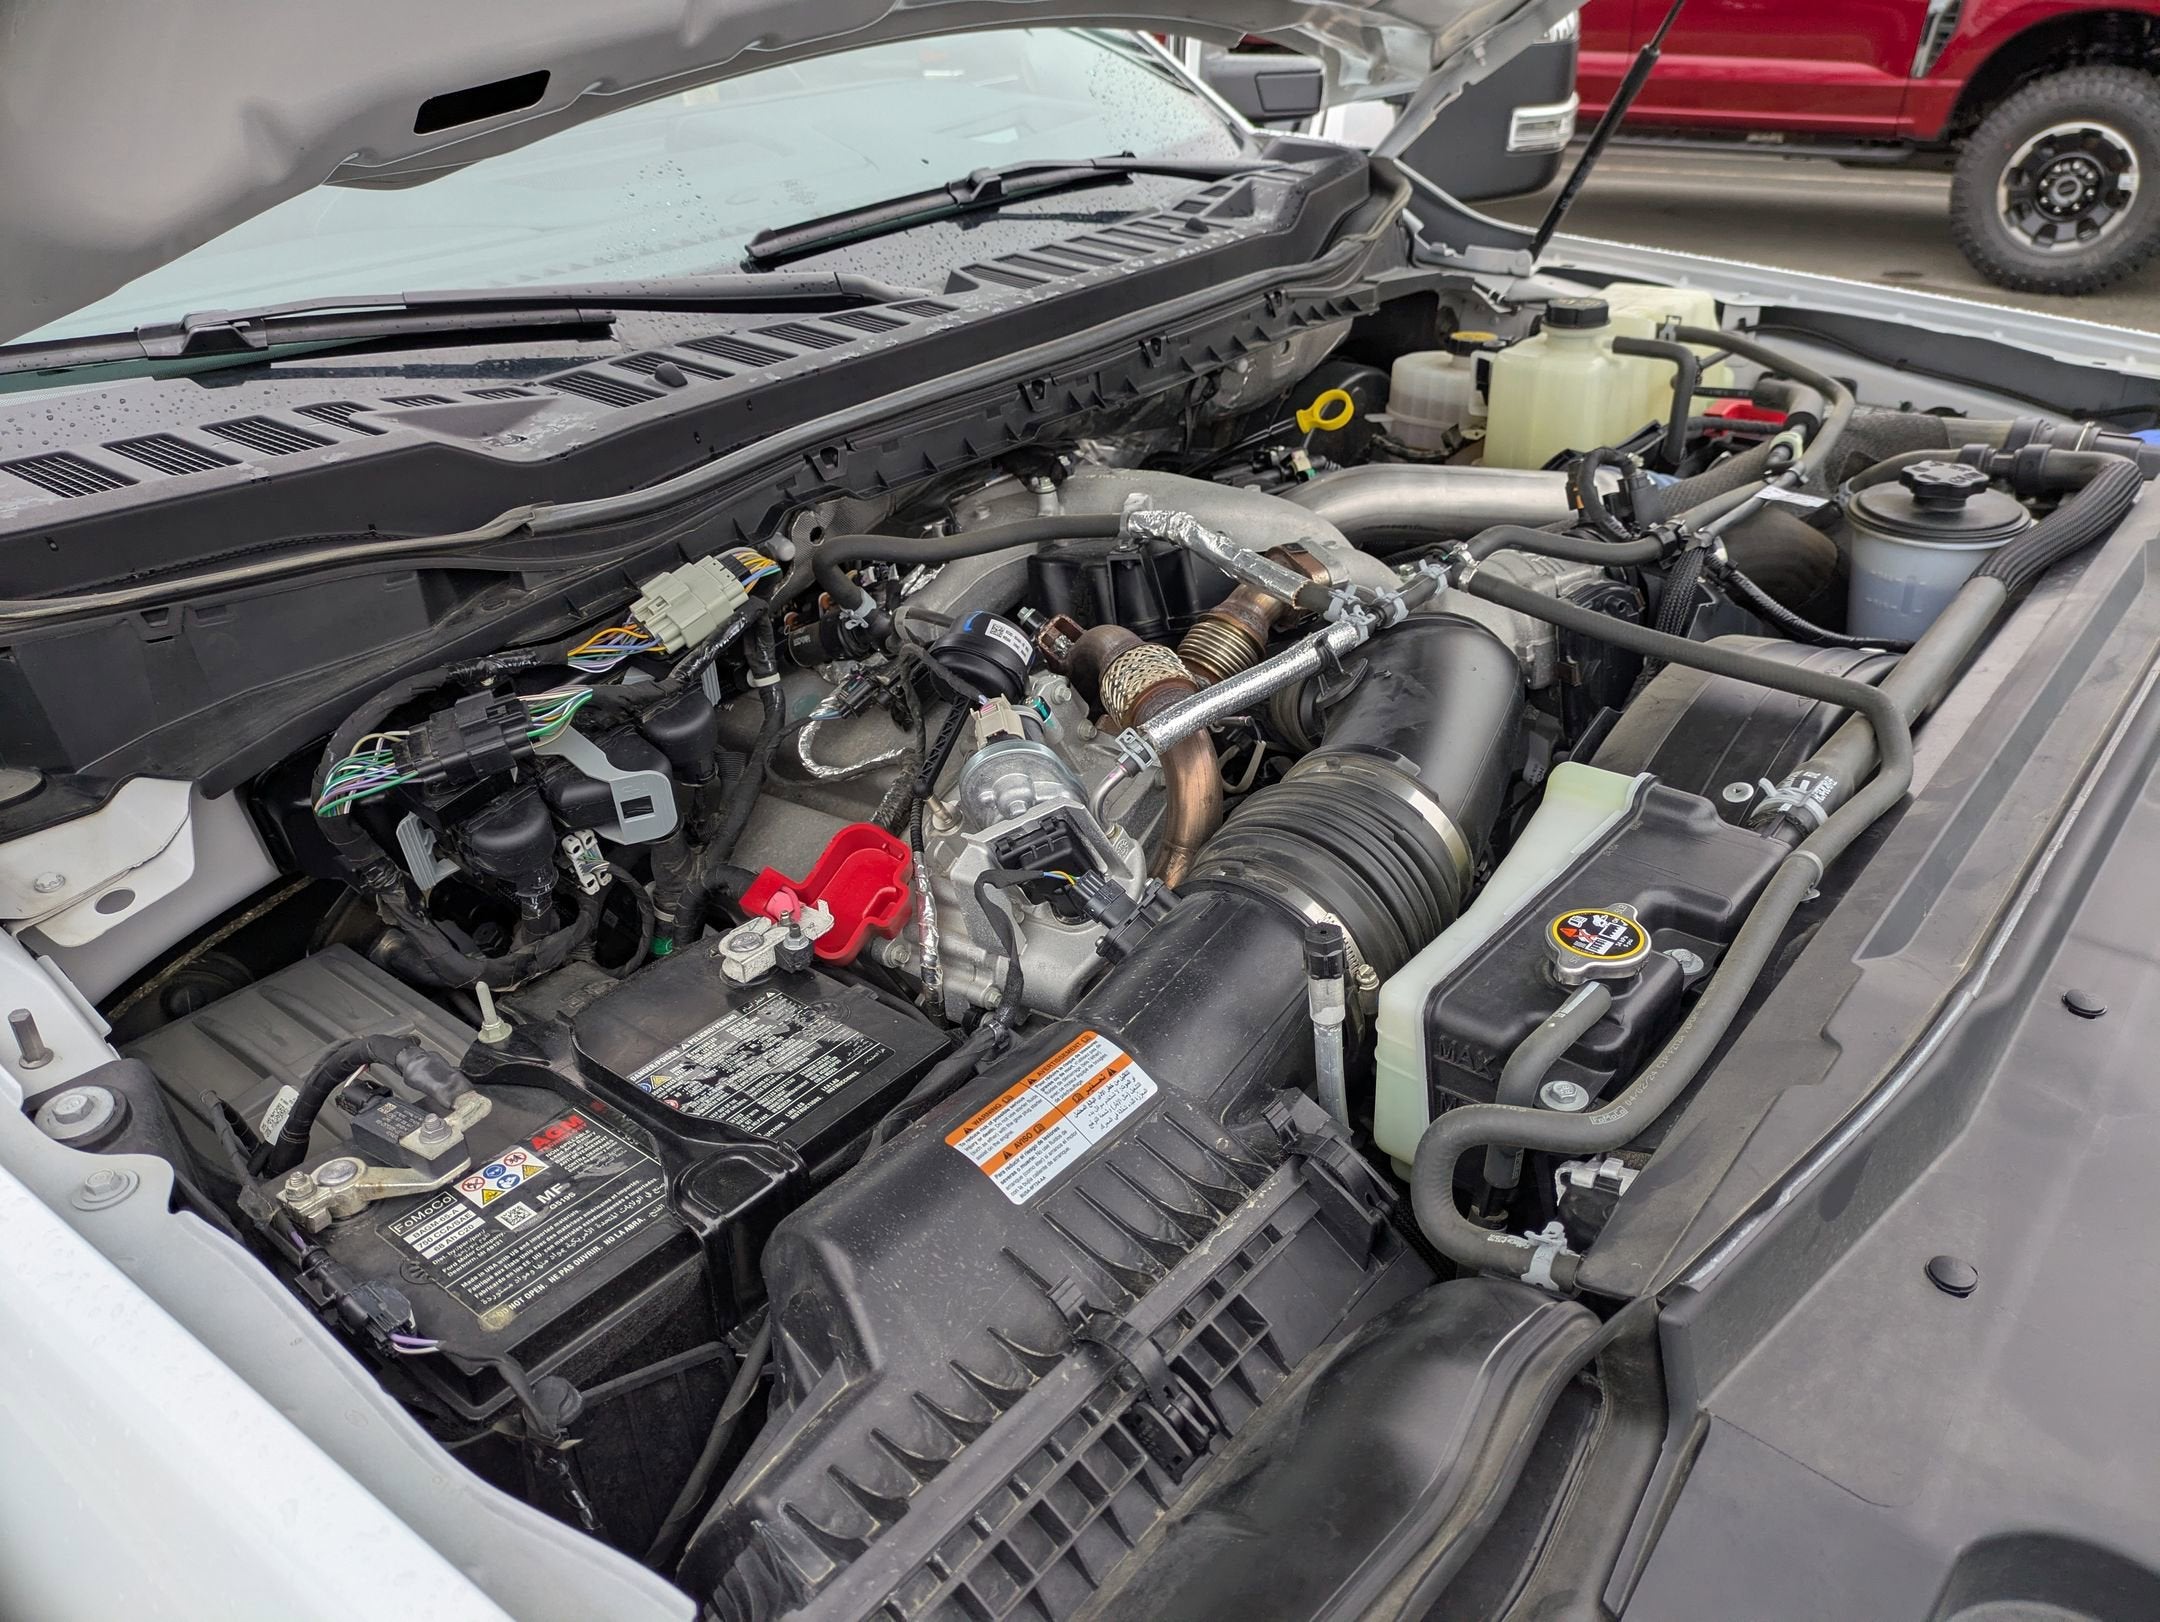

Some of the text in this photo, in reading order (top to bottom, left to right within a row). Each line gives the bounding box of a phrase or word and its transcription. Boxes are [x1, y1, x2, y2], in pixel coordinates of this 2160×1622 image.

[687, 1014, 737, 1044] PELIGRO/VENENO
[629, 1049, 679, 1081] DANGER/POISON
[1036, 1041, 1081, 1076] AVERTISSEMENT
[1440, 1035, 1496, 1080] MAX
[1034, 1079, 1045, 1088] Pour
[784, 1108, 796, 1116] LIRE
[789, 1096, 821, 1119] INSTRUCTIONS.
[964, 1130, 980, 1143] reduce
[979, 1124, 989, 1132] risk
[992, 1107, 1010, 1122] possible
[1009, 1096, 1025, 1109] serious
[971, 1102, 1002, 1125] WARNING
[1012, 1114, 1022, 1123] glow
[1021, 1107, 1032, 1116] plug
[1029, 1098, 1042, 1109] starter
[531, 1115, 583, 1149] AGM
[545, 1129, 590, 1157] NON-SPILLABLE
[549, 1131, 595, 1160] Lead Acid Battery
[1013, 1131, 1033, 1149] AVISO
[554, 1149, 576, 1163] Batterie
[563, 1138, 614, 1171] CONTRA DERRAMES
[993, 1169, 1005, 1179] Para
[1004, 1157, 1020, 1171] reducir
[1023, 1143, 1038, 1156] riesgo
[1041, 1126, 1060, 1141] lesiones
[999, 1170, 1017, 1184] severas
[1019, 1154, 1036, 1169] muerte:
[1041, 1143, 1050, 1151] use
[1047, 1133, 1062, 1145] fluidos
[1021, 1164, 1036, 1177] (como
[1065, 1130, 1077, 1141] motor
[1032, 1164, 1048, 1178] caliente
[535, 1182, 563, 1203] MF
[393, 1196, 451, 1233] FoMoCo
[412, 1209, 459, 1238] BAGM-65-A
[416, 1212, 472, 1248] 750 CCA/SAE
[445, 1235, 457, 1244] Ah
[457, 1224, 474, 1236] C20
[486, 1238, 503, 1251] 48121
[431, 1255, 447, 1265] Dist.
[460, 1275, 478, 1288] Made
[483, 1263, 498, 1272] USA
[496, 1255, 510, 1264] with
[509, 1248, 519, 1256] US
[518, 1241, 530, 1250] and
[528, 1225, 554, 1243] imported
[553, 1209, 580, 1227] materials.
[467, 1274, 494, 1293] Fabriqué
[493, 1267, 504, 1276] aux
[503, 1248, 533, 1269] États-Unis
[532, 1240, 546, 1250] avec
[545, 1233, 557, 1241] des
[555, 1215, 583, 1234] matériaux
[582, 1198, 611, 1218] américains
[512, 1265, 523, 1273] los
[543, 1244, 554, 1253] con
[553, 1225, 583, 1245] materiales
[441, 1261, 457, 1273] Ford
[456, 1249, 475, 1263] Motor
[507, 1296, 524, 1309] NOT
[523, 1283, 547, 1299] OPEN.
[547, 1273, 560, 1283] NE
[557, 1263, 574, 1276] PAS
[572, 1245, 603, 1265] OUVRIR.
[602, 1235, 615, 1245] NO
[613, 1229, 625, 1238] LA
[623, 1217, 645, 1232] ABRA.
